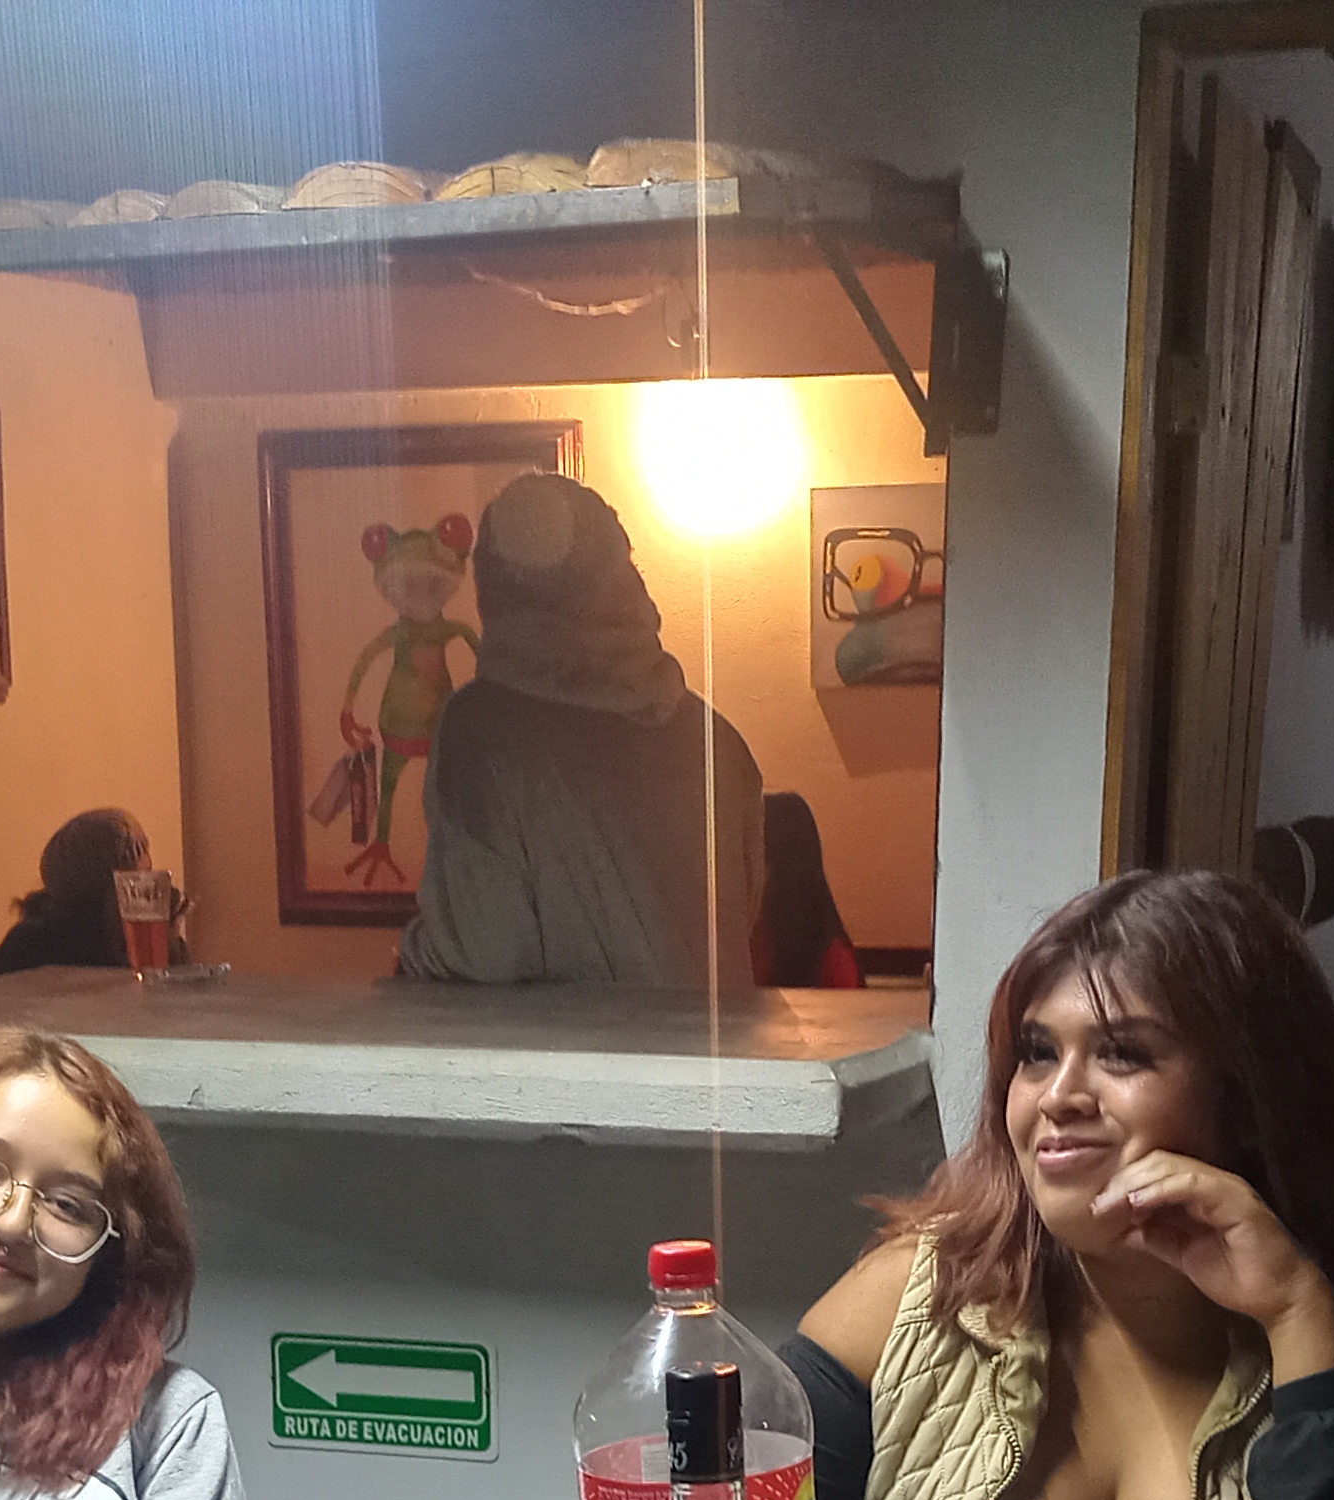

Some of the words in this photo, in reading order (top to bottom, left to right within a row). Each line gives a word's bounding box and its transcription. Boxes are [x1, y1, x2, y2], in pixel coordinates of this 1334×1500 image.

[284, 1415, 332, 1438] RUTA
[335, 1418, 359, 1440] DE
[362, 1420, 480, 1448] EVACUACION
